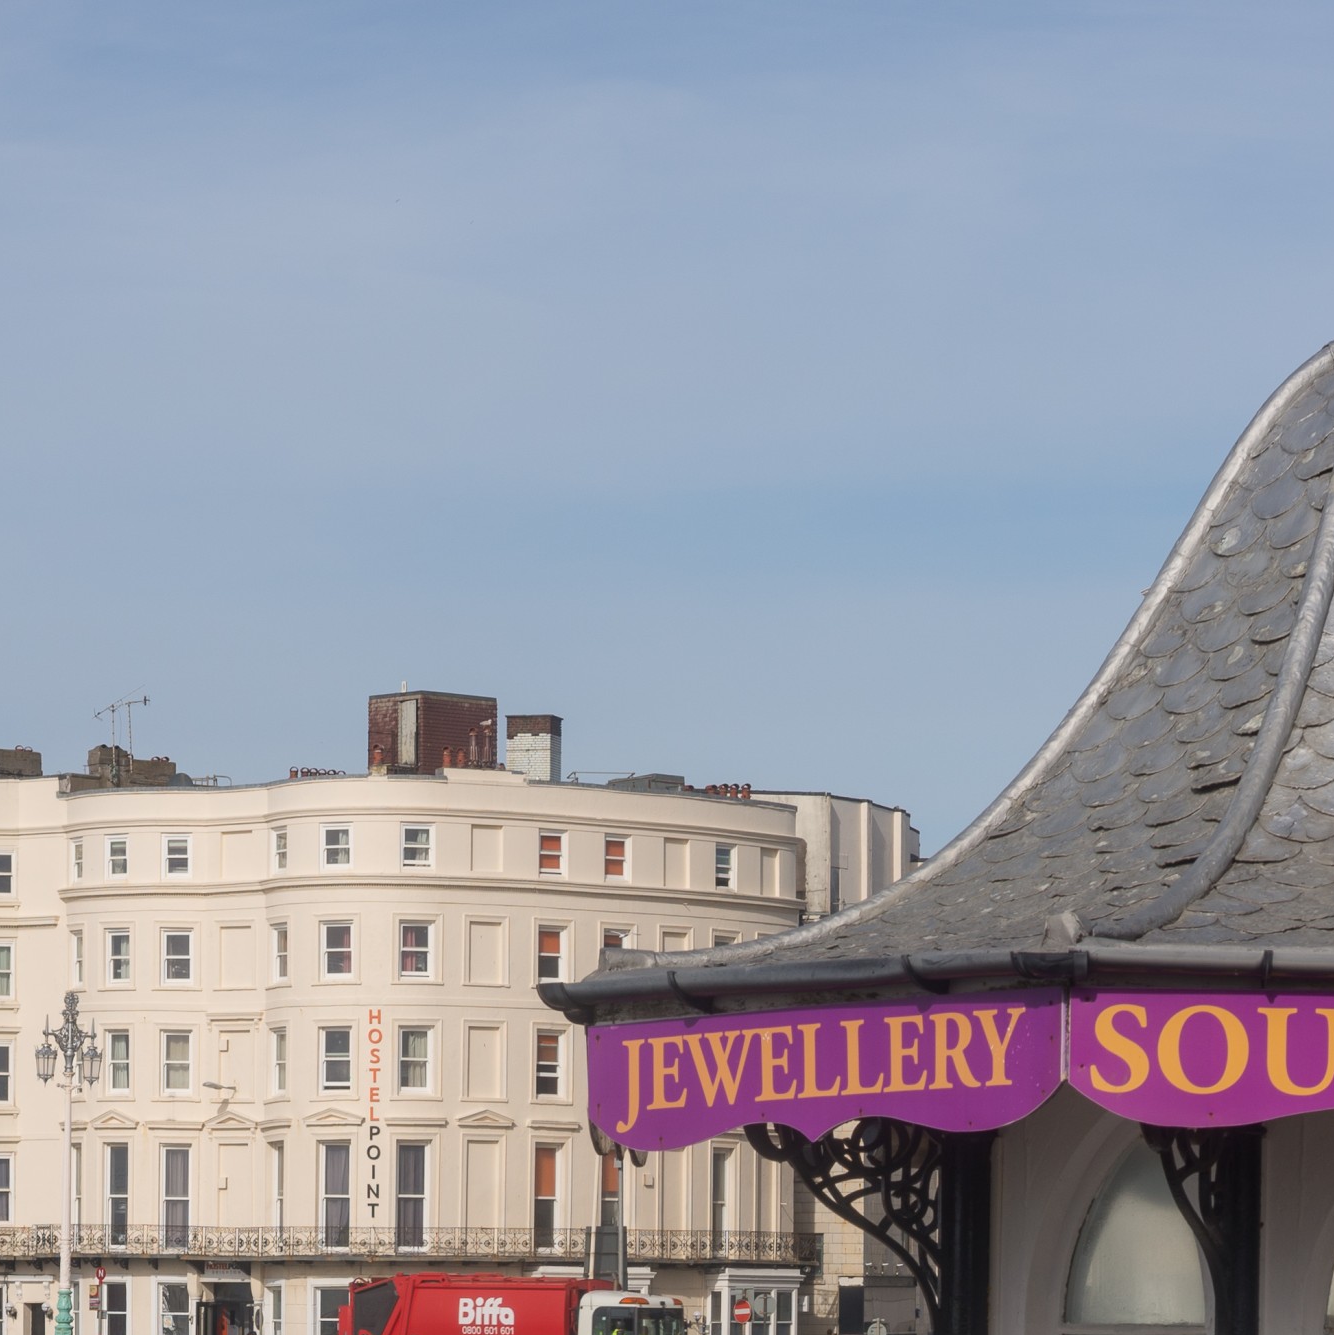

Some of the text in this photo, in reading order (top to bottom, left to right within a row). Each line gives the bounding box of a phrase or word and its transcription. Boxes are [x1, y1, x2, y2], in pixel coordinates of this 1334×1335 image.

[616, 1006, 1026, 1134] JEWELLERY
[458, 1297, 515, 1326] Biffa
[461, 1326, 515, 1335] 0800 601 601
